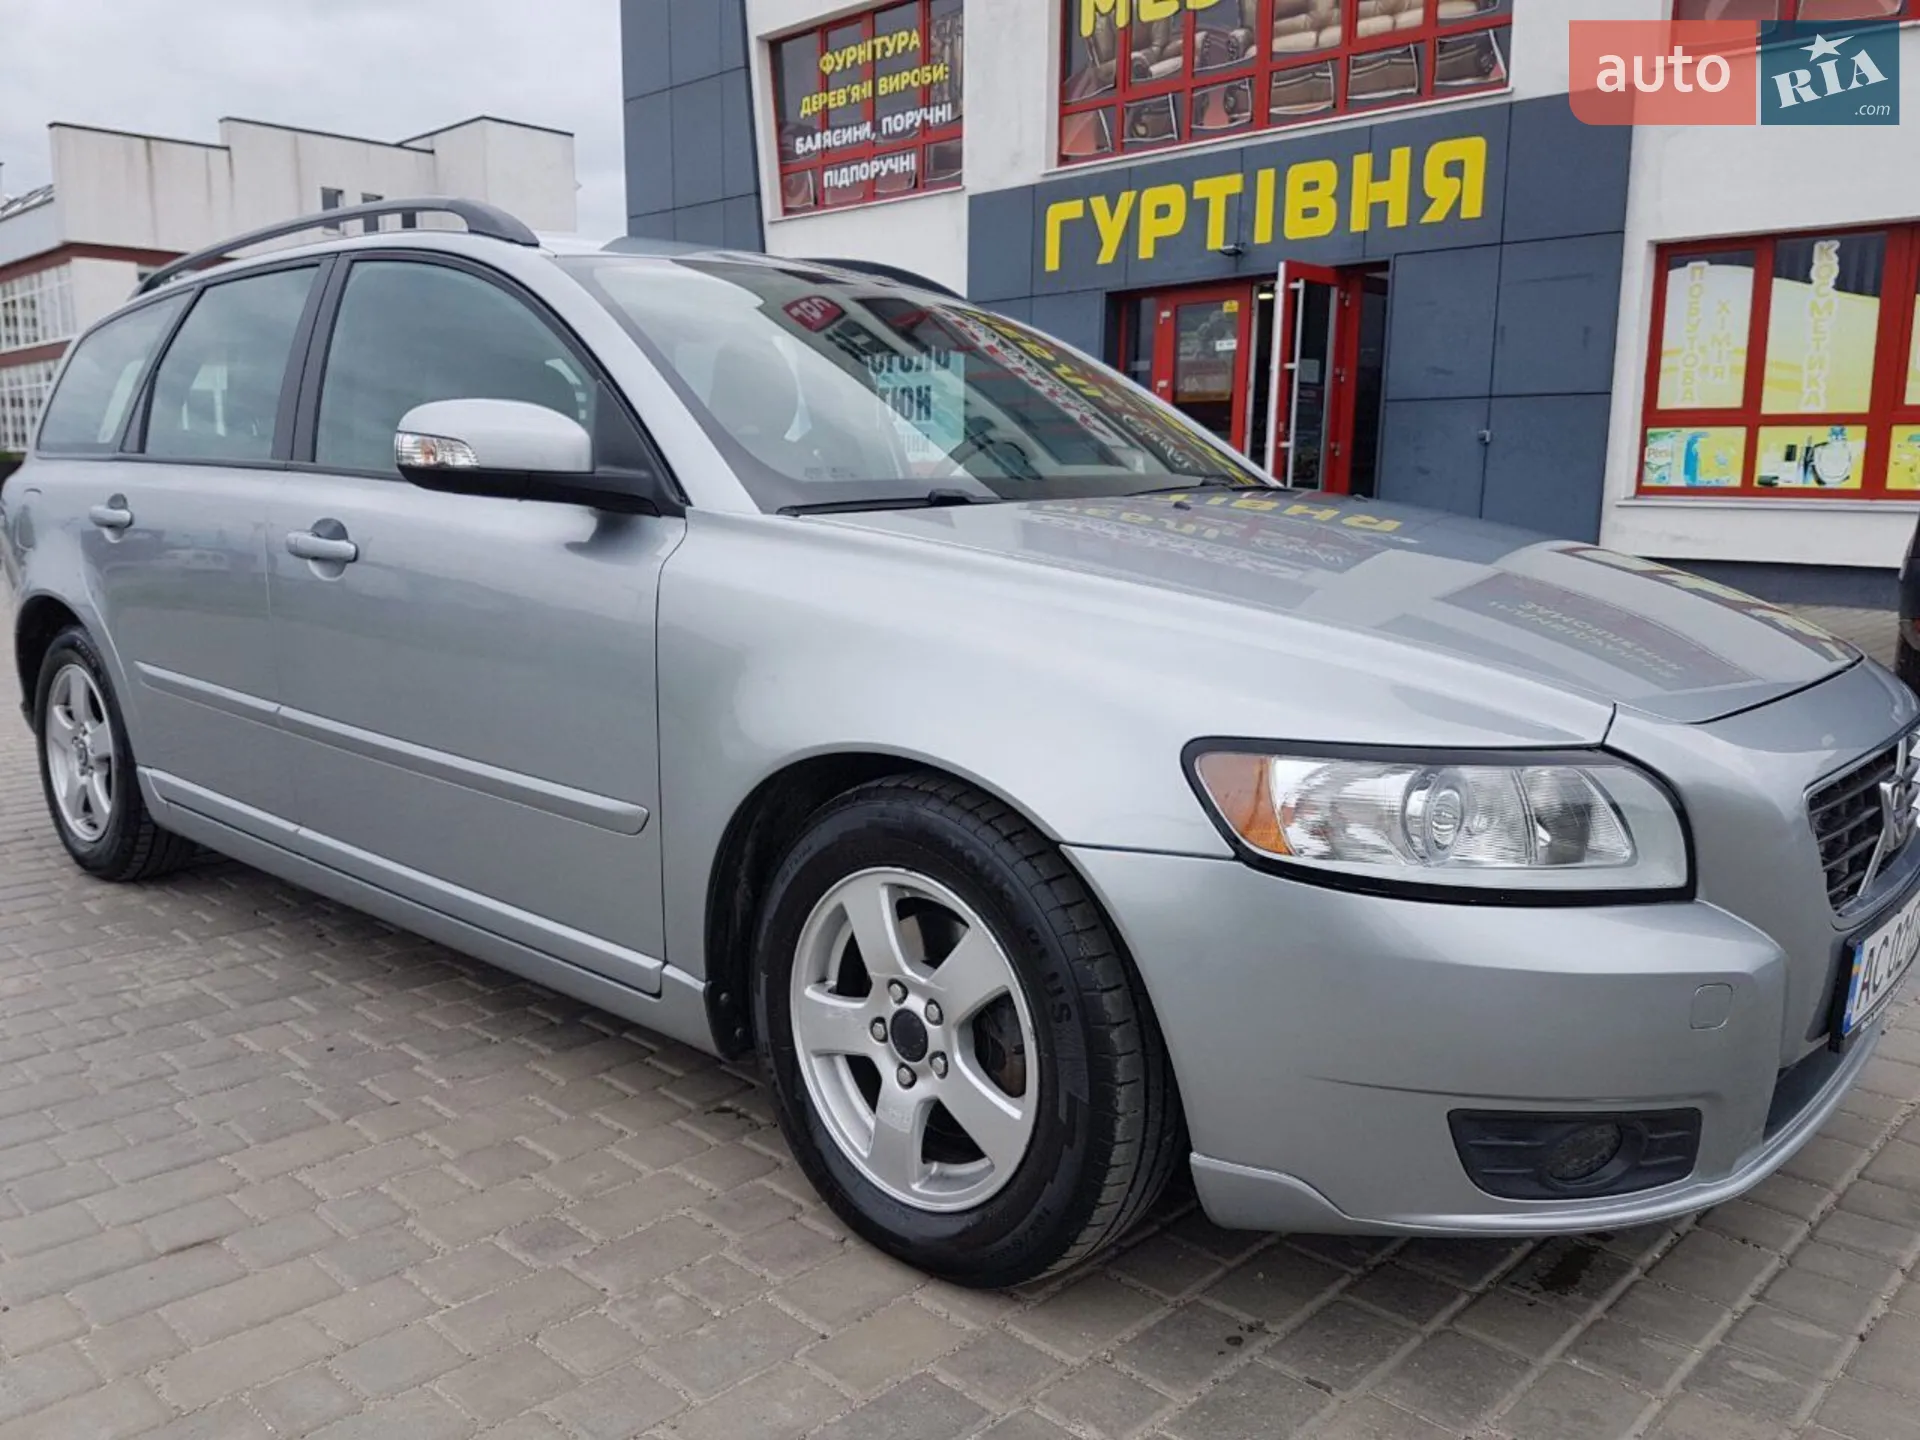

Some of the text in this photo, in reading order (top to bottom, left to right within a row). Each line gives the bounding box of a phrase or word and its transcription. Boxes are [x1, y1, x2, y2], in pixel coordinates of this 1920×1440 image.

[819, 28, 921, 75] ФУРНІТУРА
[878, 63, 950, 97] ВИРОБИ:
[881, 103, 952, 135] ПОРУЧНІ
[823, 153, 916, 189] ПІДПОРУЧНІ
[1045, 136, 1487, 272] ГУРТІВНЯ
